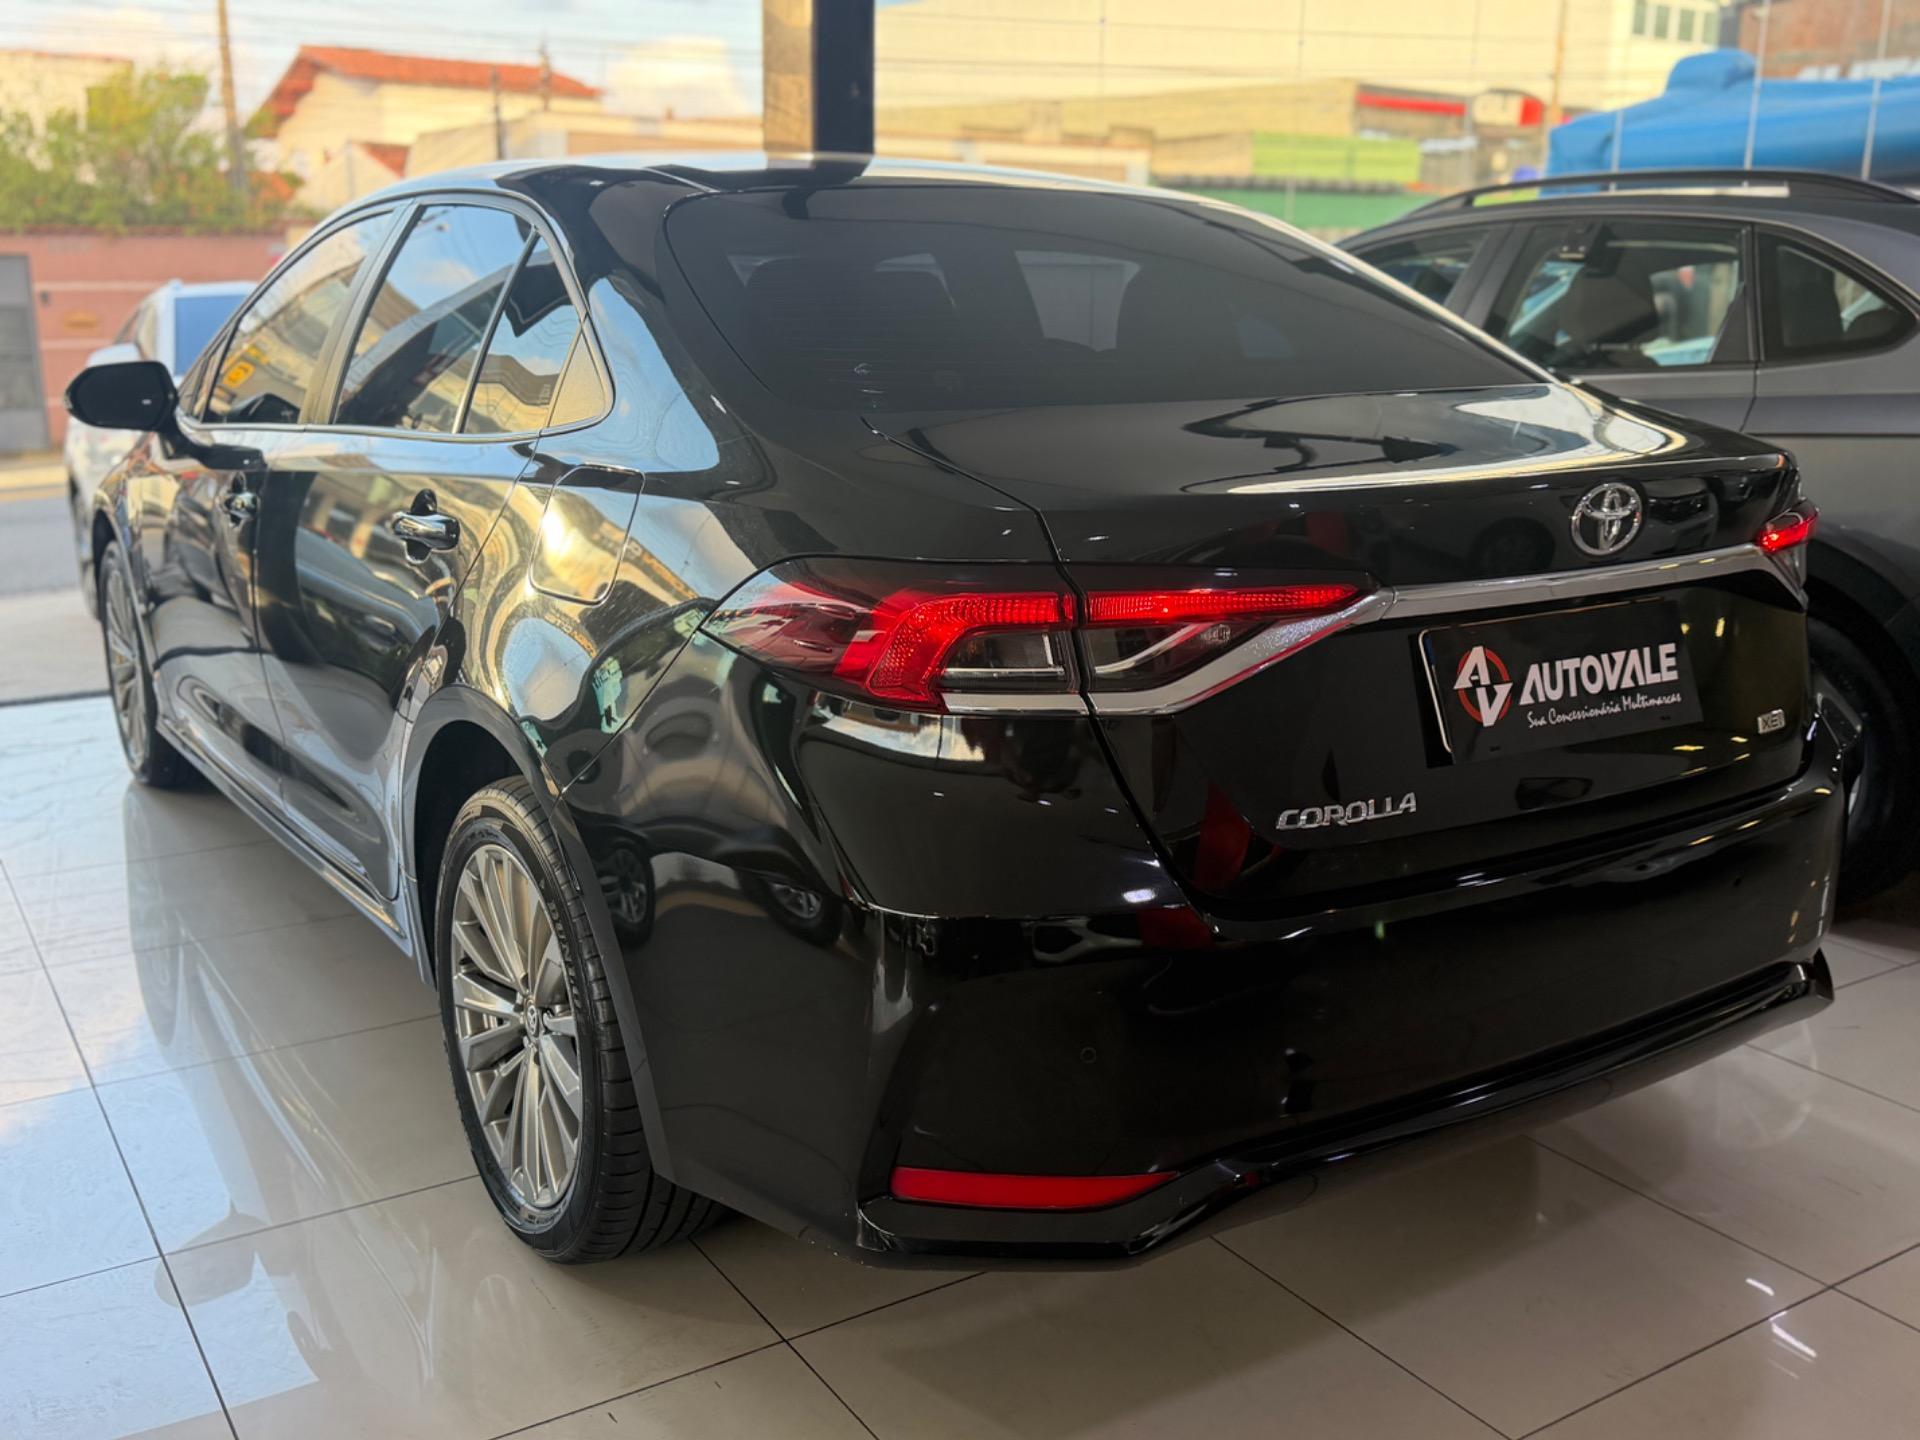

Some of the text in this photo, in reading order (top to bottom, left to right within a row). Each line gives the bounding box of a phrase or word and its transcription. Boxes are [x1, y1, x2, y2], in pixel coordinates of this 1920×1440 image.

[1519, 643, 1679, 705] AUTOVALE
[1527, 692, 1682, 728] Sua Concessionária Multimarcas
[1276, 792, 1417, 830] COROLLA
